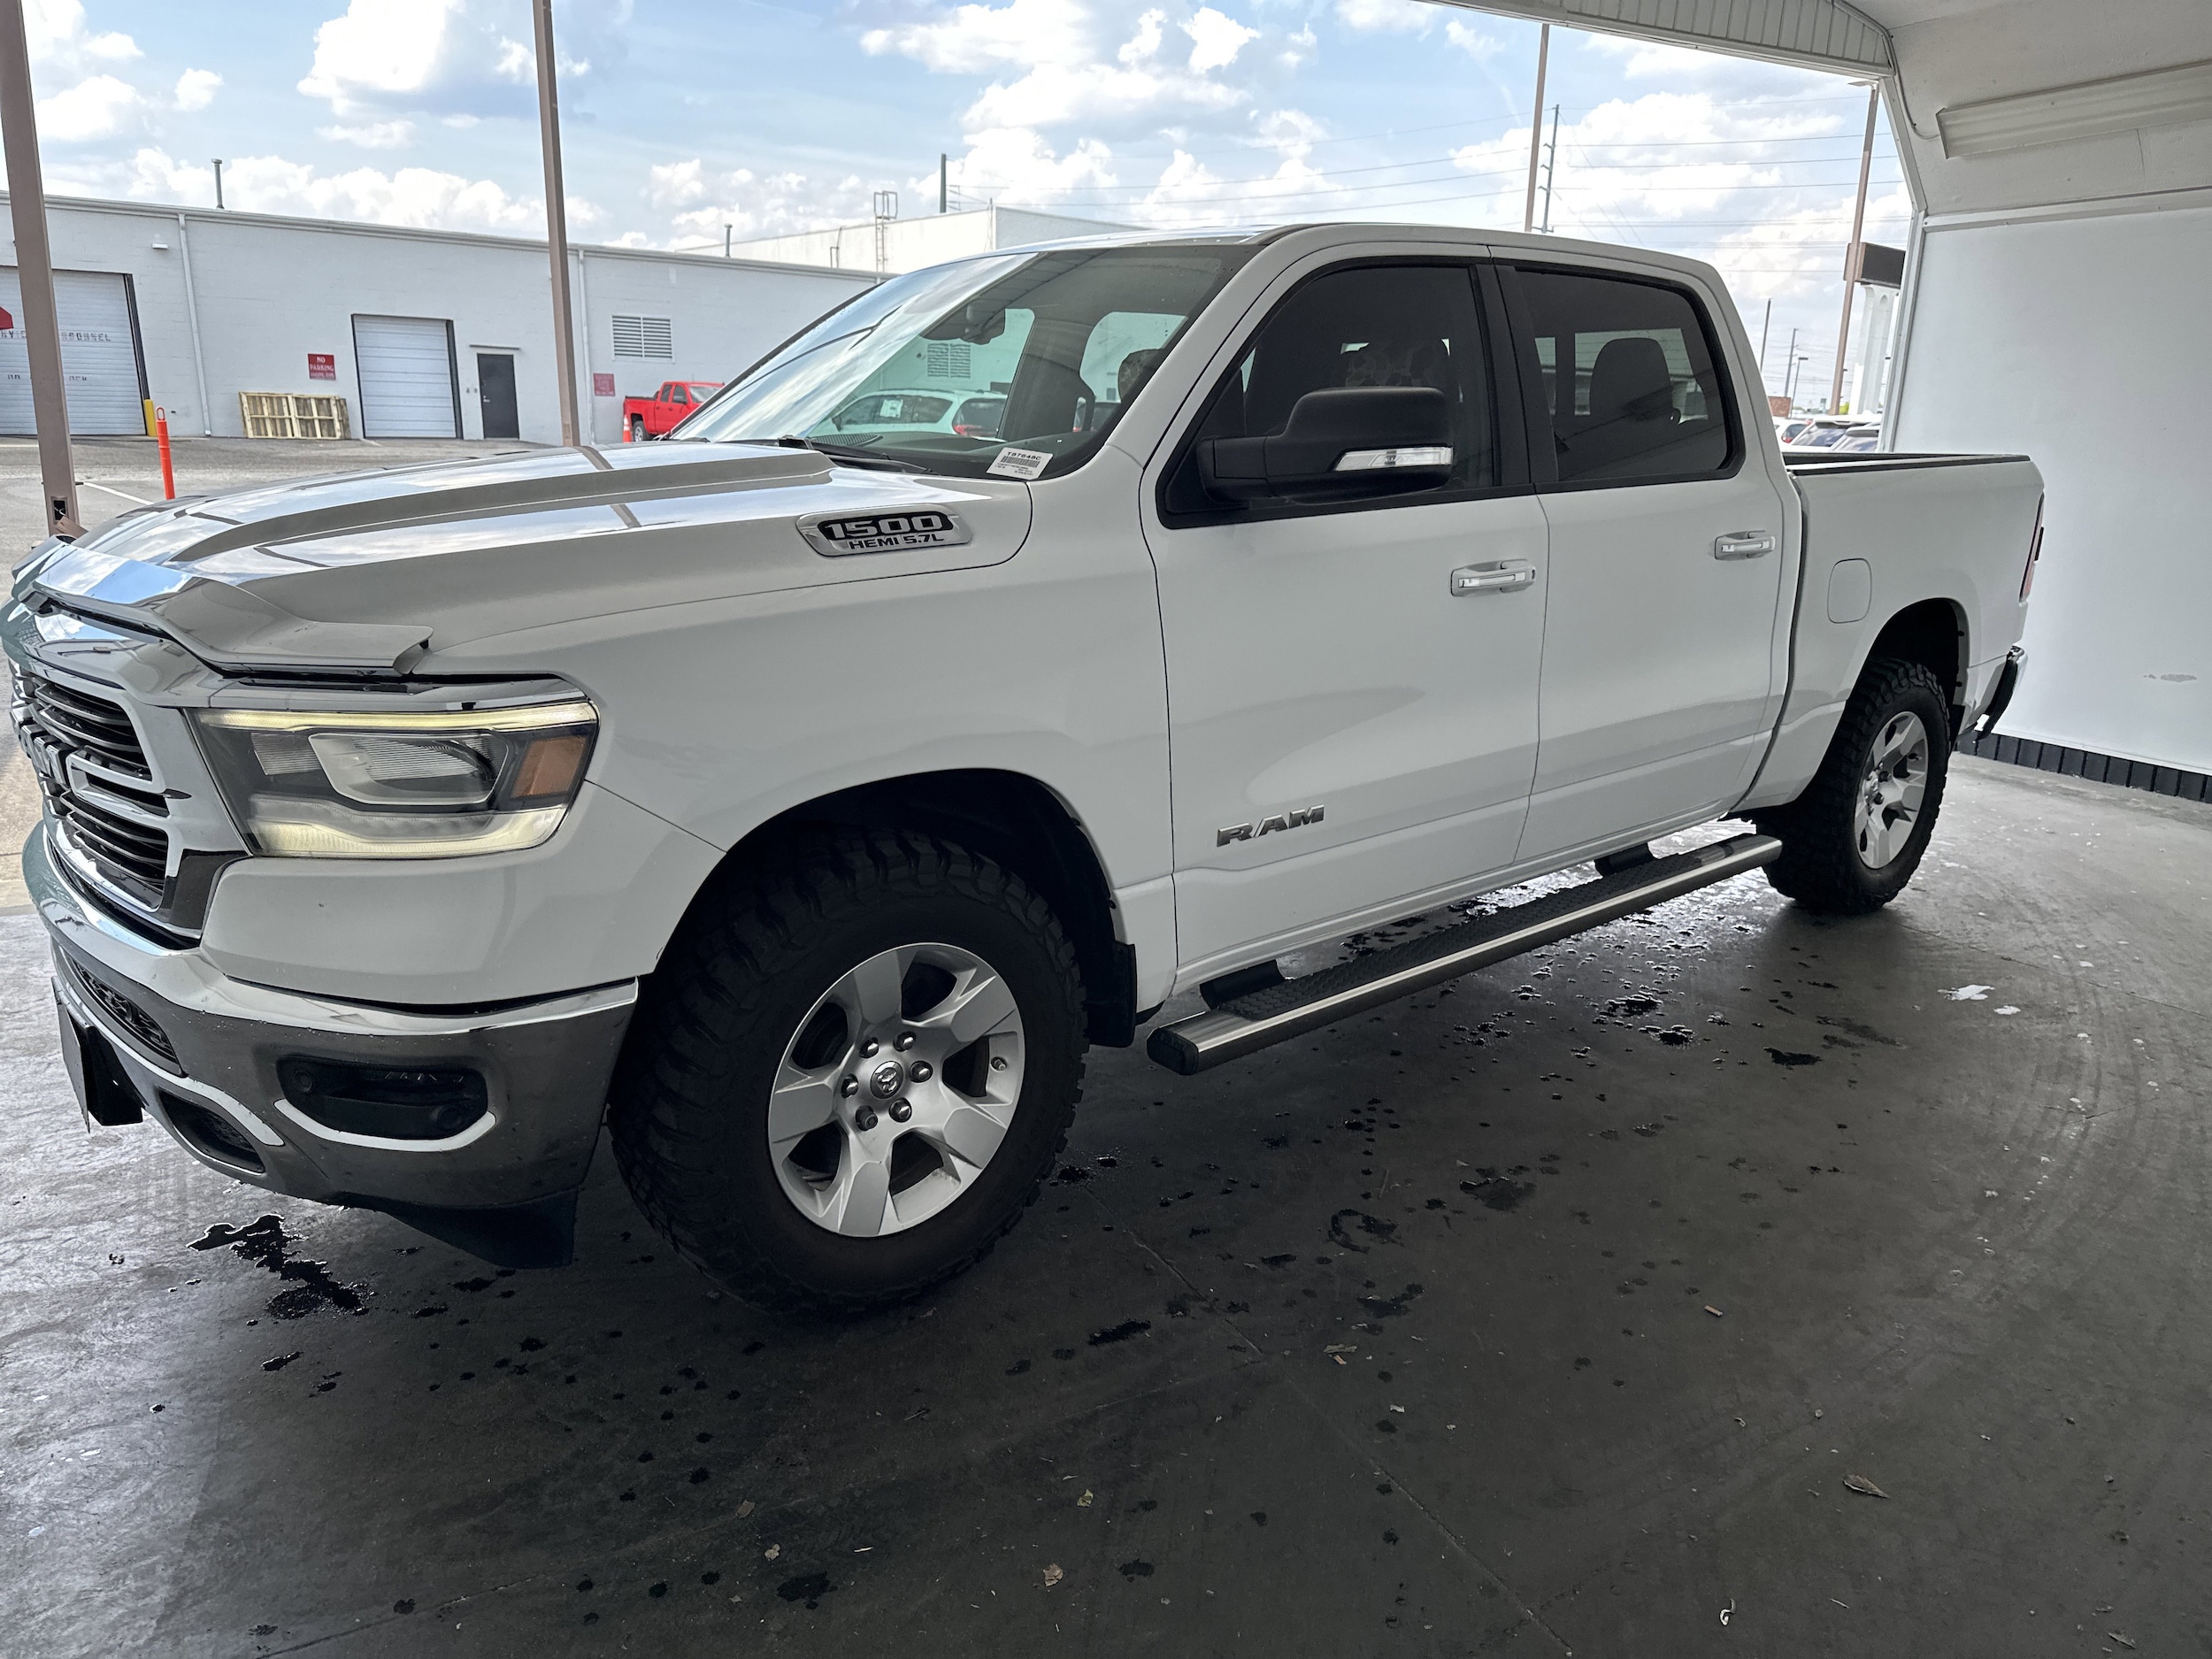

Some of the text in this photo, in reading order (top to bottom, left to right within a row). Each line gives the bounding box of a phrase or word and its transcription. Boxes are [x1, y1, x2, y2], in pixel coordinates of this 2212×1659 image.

[823, 514, 944, 539] 1500
[849, 534, 945, 549] HEMI 5.7L
[1216, 804, 1325, 848] RAM
